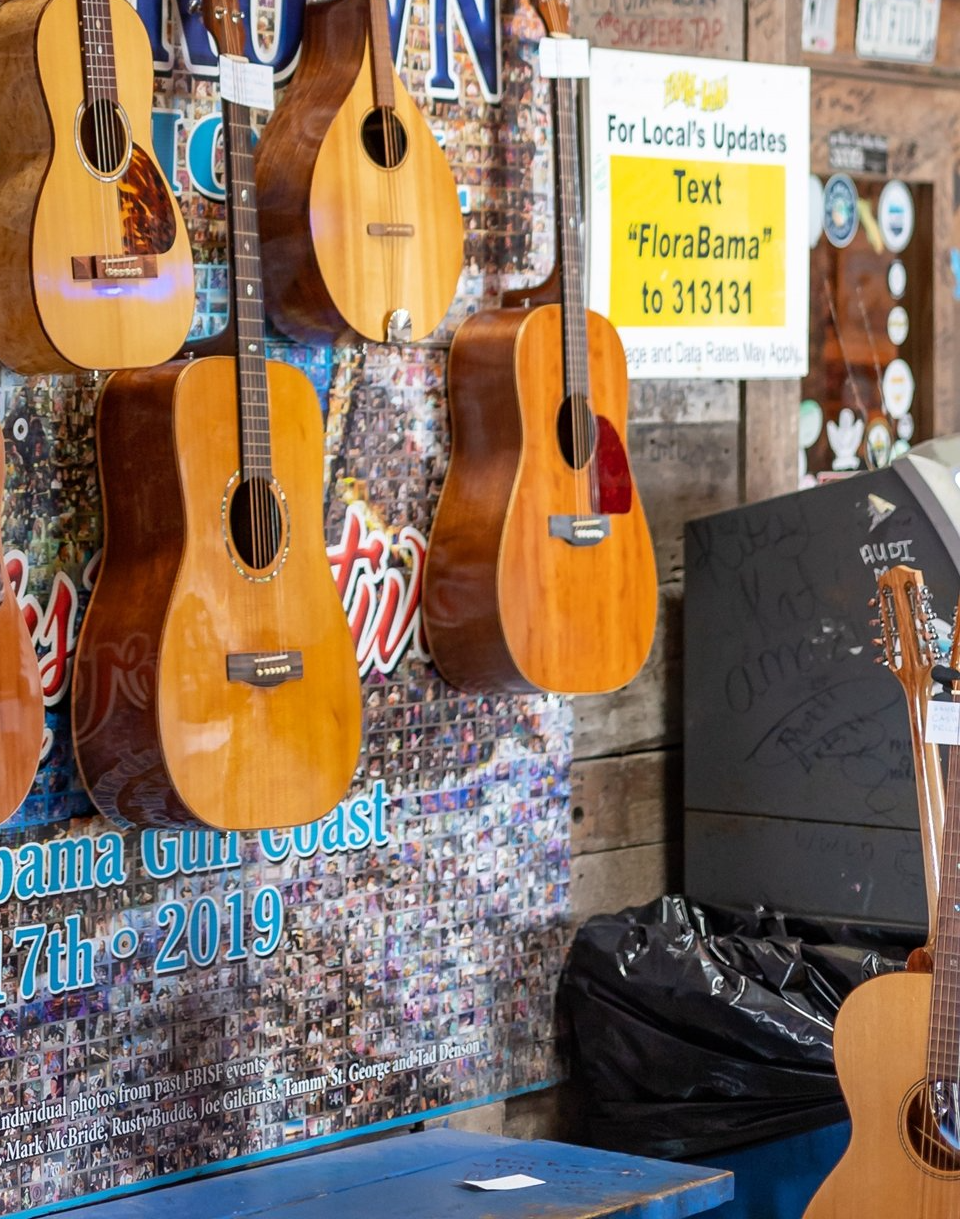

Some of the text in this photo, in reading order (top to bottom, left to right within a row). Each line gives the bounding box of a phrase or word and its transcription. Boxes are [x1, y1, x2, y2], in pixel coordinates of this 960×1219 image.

[608, 115, 787, 157] For Local's Updates
[673, 169, 722, 205] Text
[642, 280, 753, 315] to 313131
[652, 345, 672, 364] and
[676, 342, 702, 364] Data
[706, 342, 740, 365] Rates
[743, 343, 767, 368] May
[153, 884, 284, 973] 2019
[6, 1137, 44, 1163] Mark
[47, 1123, 110, 1153] McBride,
[112, 1113, 150, 1140] Rusty
[152, 1101, 198, 1130] Budde,
[200, 1096, 221, 1121] Joe
[222, 1080, 281, 1113] Gilchrist,
[283, 1076, 329, 1102] Tammy
[330, 1067, 347, 1087] St.
[349, 1060, 392, 1084] George
[392, 1050, 414, 1073] and
[415, 1044, 439, 1067] Tad
[439, 1037, 482, 1064] Denson
[70, 1088, 116, 1122] photos
[118, 1082, 153, 1106] from
[154, 1075, 182, 1102] past
[184, 1061, 224, 1091] FBISF
[226, 1055, 267, 1080] events
